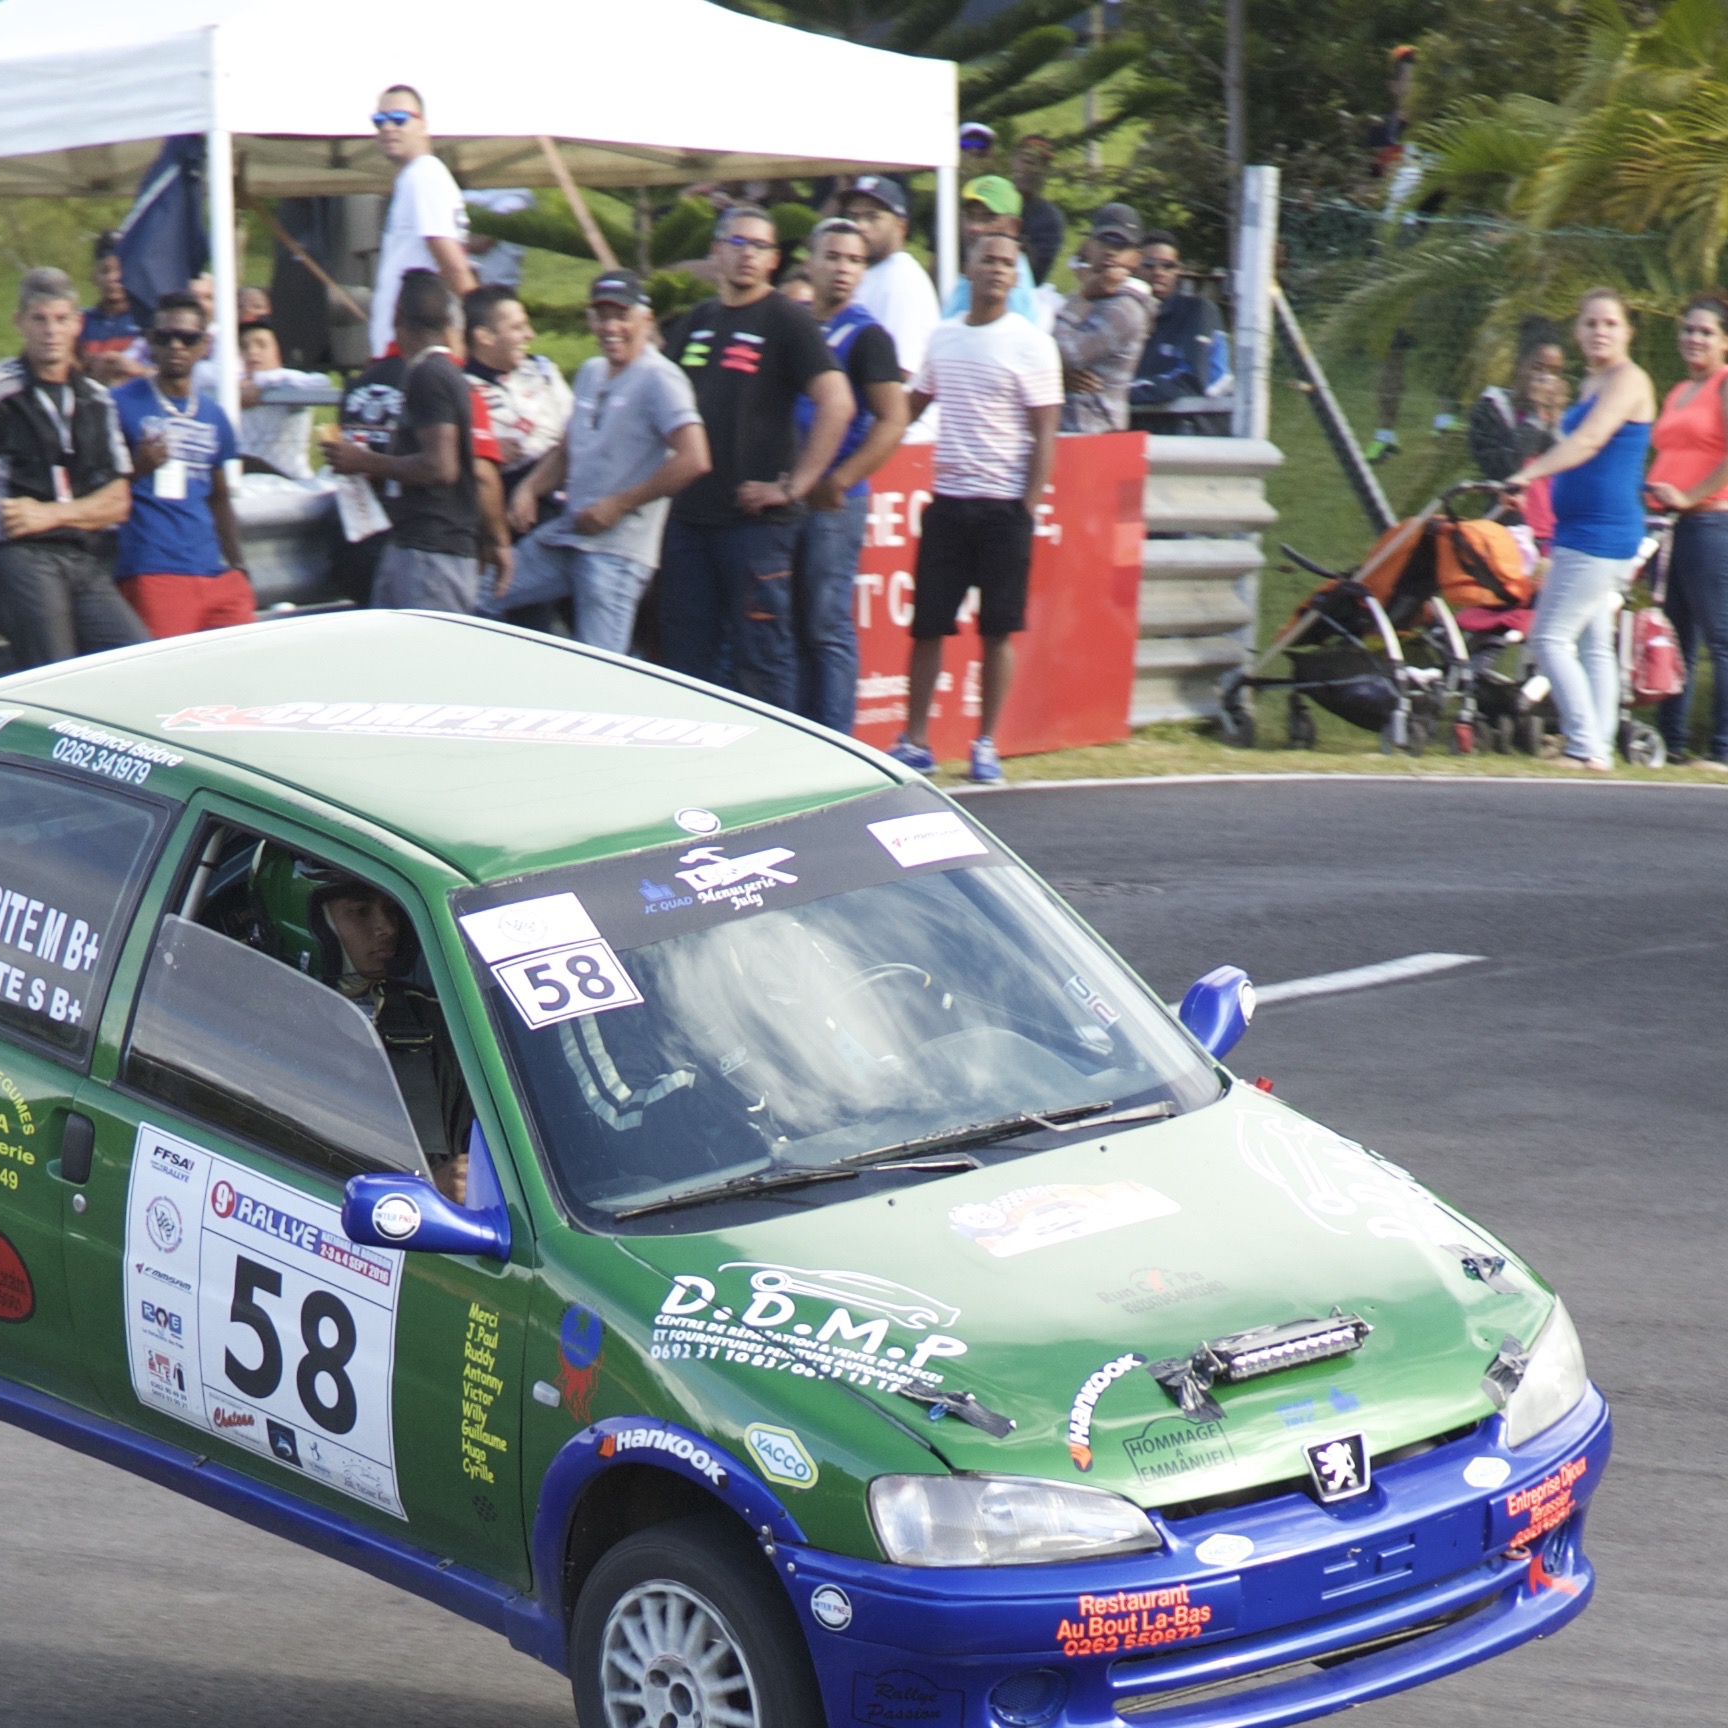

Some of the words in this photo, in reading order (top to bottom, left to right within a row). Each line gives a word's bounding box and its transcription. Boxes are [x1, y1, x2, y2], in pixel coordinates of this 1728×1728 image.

[48, 719, 133, 752] Ambulance
[127, 741, 184, 767] Isidore
[52, 737, 96, 768] 0262
[92, 749, 152, 784] 341979
[660, 896, 693, 911] QUAD
[730, 892, 764, 911] July
[36, 907, 68, 963] M
[62, 919, 100, 971] B+
[523, 954, 616, 1012] 58
[27, 977, 47, 1011] S
[49, 986, 82, 1024] B+
[236, 1197, 319, 1251] RALLYE
[349, 1255, 369, 1274] SEPT
[469, 1302, 500, 1328] Merci
[225, 1254, 357, 1435] 58
[464, 1341, 496, 1373] Ruddy
[650, 1342, 692, 1360] 0692
[696, 1344, 719, 1359] 31
[724, 1348, 750, 1362] 10
[653, 1328, 668, 1342] ET
[668, 1329, 764, 1354] FOURNITURES
[654, 1314, 707, 1331] CENTRE
[707, 1322, 727, 1334] DE
[818, 1343, 830, 1353] &
[831, 1346, 878, 1364] VENTE
[877, 1356, 898, 1370] DE
[462, 1380, 495, 1407] Victor
[461, 1399, 488, 1428] Willy
[461, 1419, 508, 1452] Guillaume
[461, 1437, 487, 1464] Hugo
[1129, 1423, 1219, 1457] HOMMAGE
[462, 1457, 495, 1484] Cyrille
[756, 1432, 807, 1478] YACCO
[1139, 1449, 1231, 1482] EMMANUEL
[1506, 1475, 1562, 1517] Entreprise
[812, 1599, 832, 1612] INTER
[1079, 1583, 1190, 1617] Restaurant
[1056, 1619, 1085, 1641] Au
[1088, 1612, 1138, 1637] Bout
[1141, 1605, 1212, 1632] La-Bas
[1063, 1636, 1119, 1657] 0262
[864, 1703, 940, 1720] Passion
